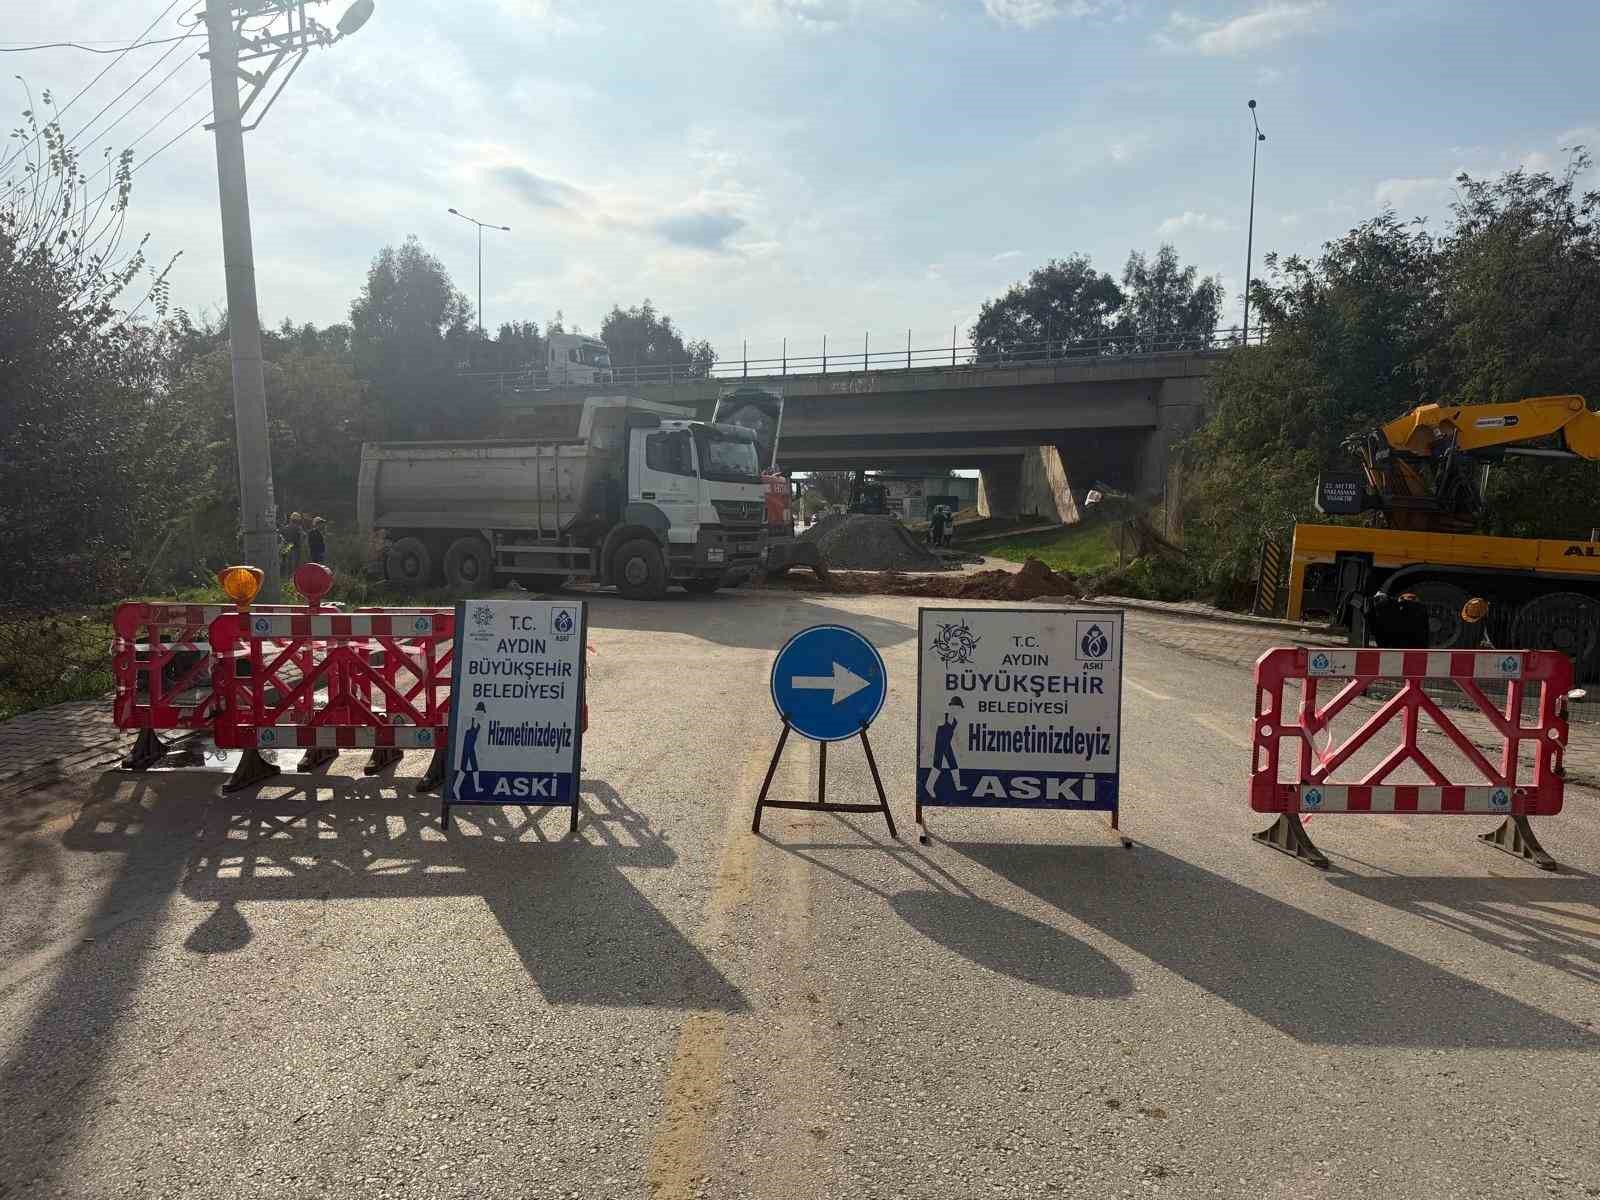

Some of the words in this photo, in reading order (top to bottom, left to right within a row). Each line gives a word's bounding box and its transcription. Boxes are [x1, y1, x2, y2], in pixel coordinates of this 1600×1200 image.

[510, 616, 536, 631] T.C.
[497, 638, 546, 654] AYDIN
[1012, 636, 1040, 648] T.C.
[468, 658, 573, 682] BÜYÜKŞEHİR
[1002, 653, 1049, 667] AYDIN
[472, 681, 565, 699] BELEDİYESİ
[945, 669, 1104, 697] BÜYÜKŞEHİR
[978, 698, 1068, 715] BELEDİYESİ
[488, 719, 571, 754] Hizmetinizdeyiz
[968, 722, 1111, 761] Hizmetinizdeyiz
[493, 773, 559, 797] ASKİ
[972, 773, 1097, 802] ASKİ
